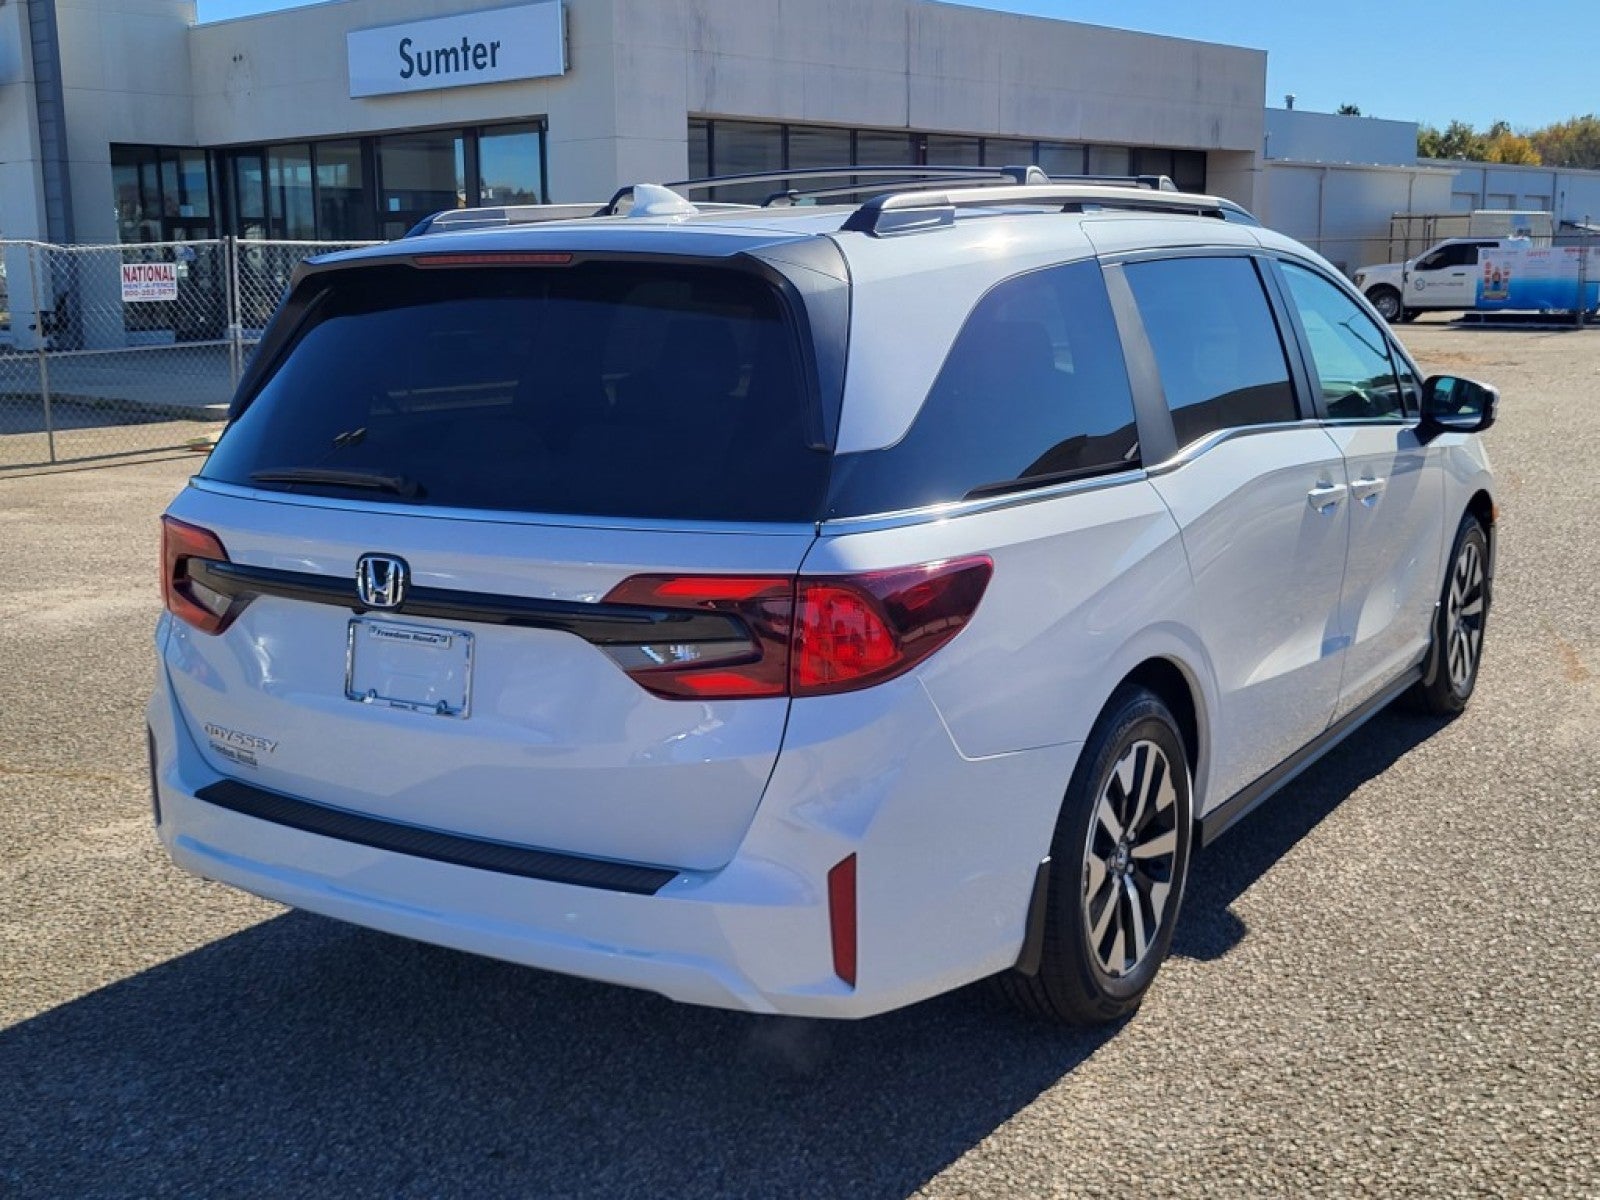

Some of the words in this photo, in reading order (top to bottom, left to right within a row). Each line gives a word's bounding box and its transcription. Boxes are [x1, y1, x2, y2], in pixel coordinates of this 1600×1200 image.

[399, 37, 501, 79] Sumter
[123, 265, 175, 282] NATIONAL
[204, 722, 279, 753] ODYSSEY
